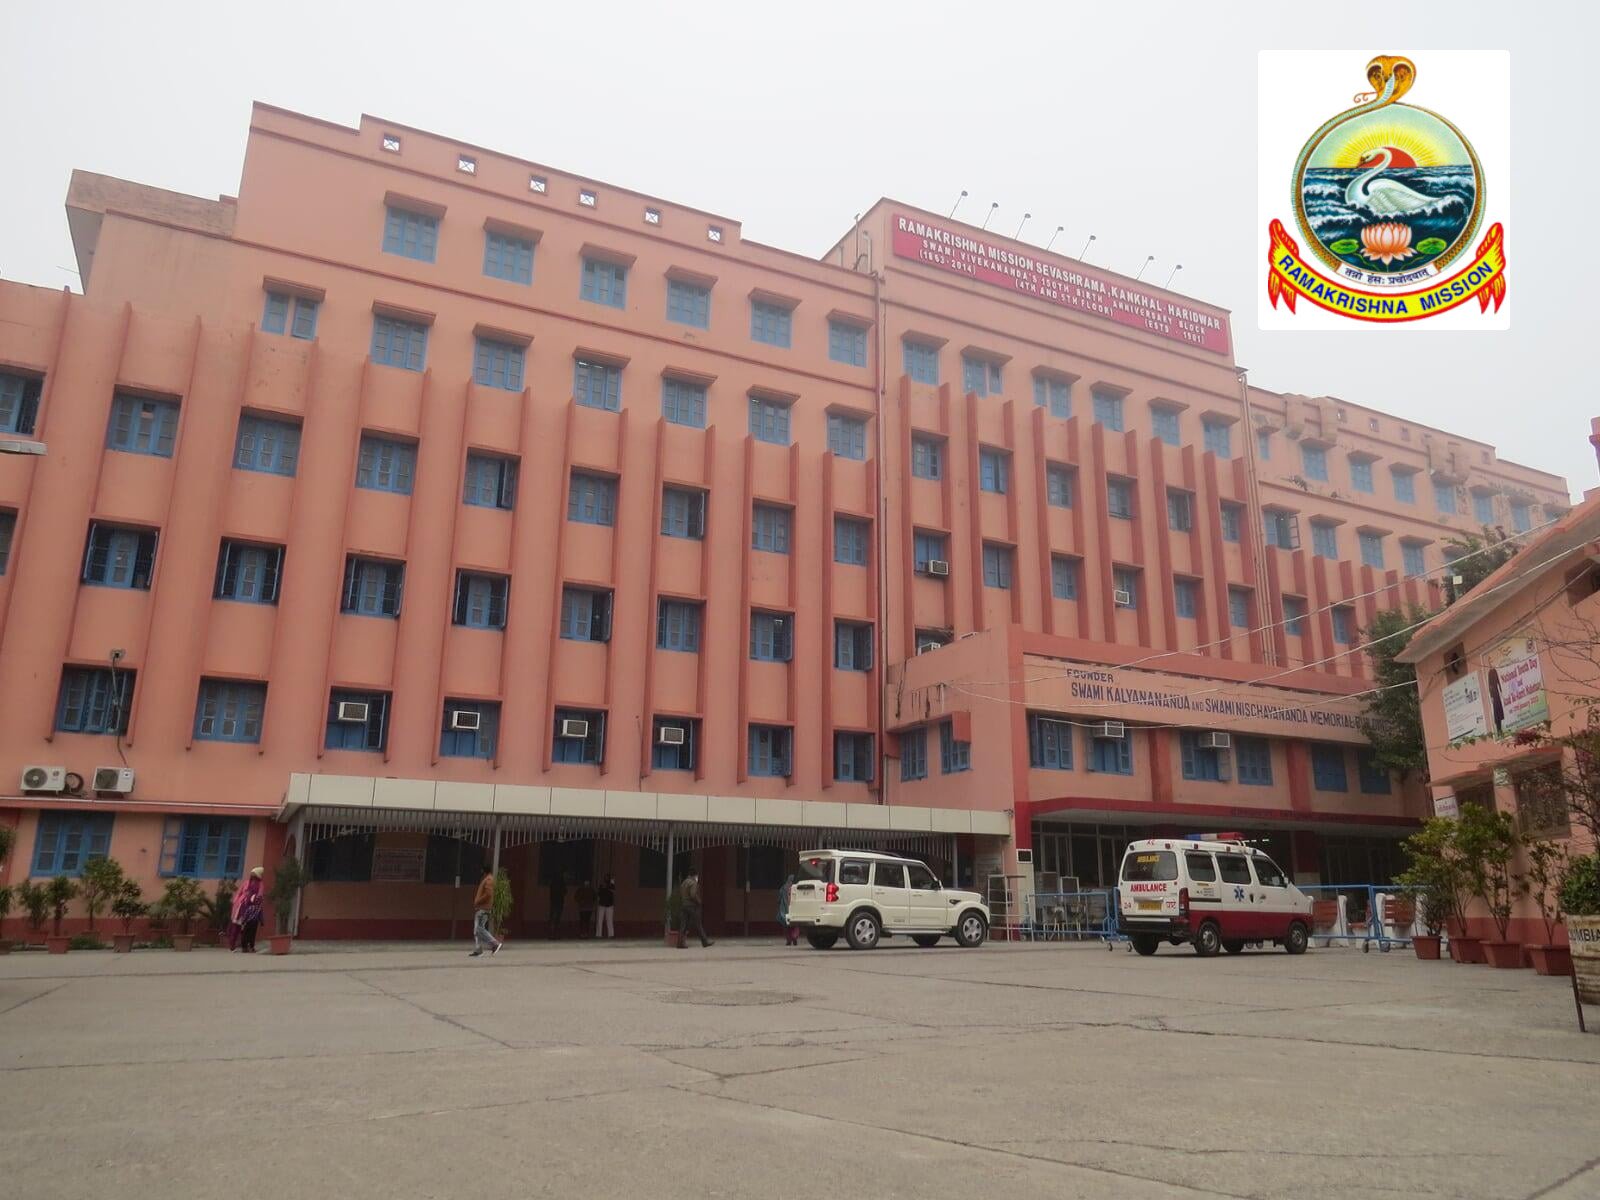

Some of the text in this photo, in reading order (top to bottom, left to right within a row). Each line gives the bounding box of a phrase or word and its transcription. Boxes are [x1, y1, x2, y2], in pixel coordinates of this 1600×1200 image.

[899, 217, 985, 256] RAMAKRISHNA
[988, 246, 1034, 271] MISSION
[1168, 303, 1220, 330] HARIDWAR
[922, 239, 955, 258] SWAMI
[1041, 278, 1070, 293] 150TH
[1076, 288, 1103, 303] BIRTH
[1112, 300, 1172, 325] ANNIVERSARY
[1178, 320, 1205, 335] BLOCK
[1040, 287, 1057, 299] AND
[1066, 668, 1114, 683] FOUNDER
[1071, 682, 1104, 701] SWAMI
[1193, 701, 1204, 712] AND
[1205, 698, 1234, 717] SWAMI
[1310, 711, 1354, 728] MEMORIAL
[1130, 882, 1168, 893] AMBULANCE
